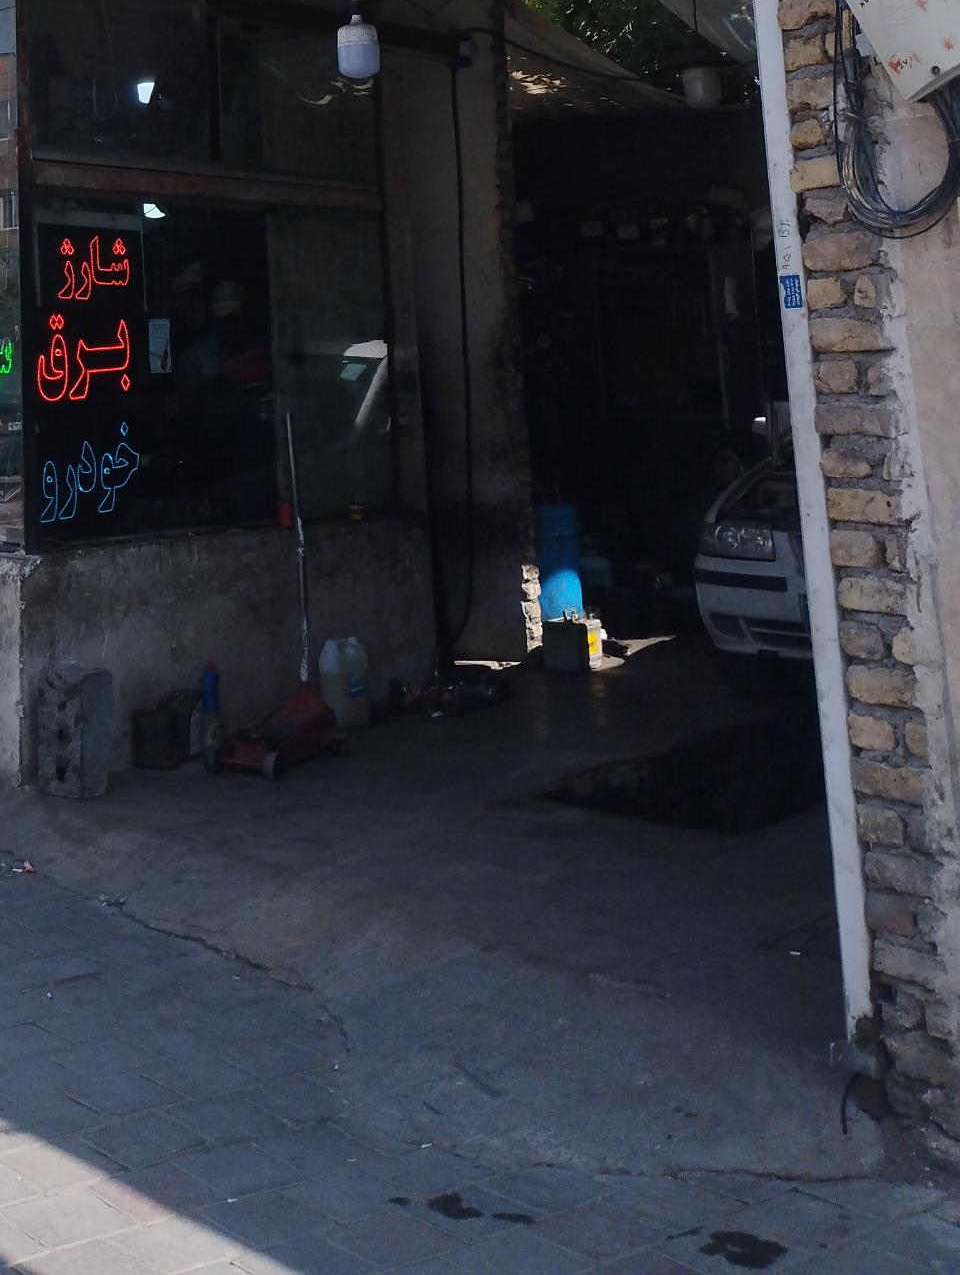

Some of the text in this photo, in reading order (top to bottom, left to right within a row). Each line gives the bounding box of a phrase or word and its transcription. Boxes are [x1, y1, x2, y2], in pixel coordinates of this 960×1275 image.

[58, 235, 130, 300] شارژ
[37, 314, 131, 402] برق
[40, 422, 140, 524] خودرو
